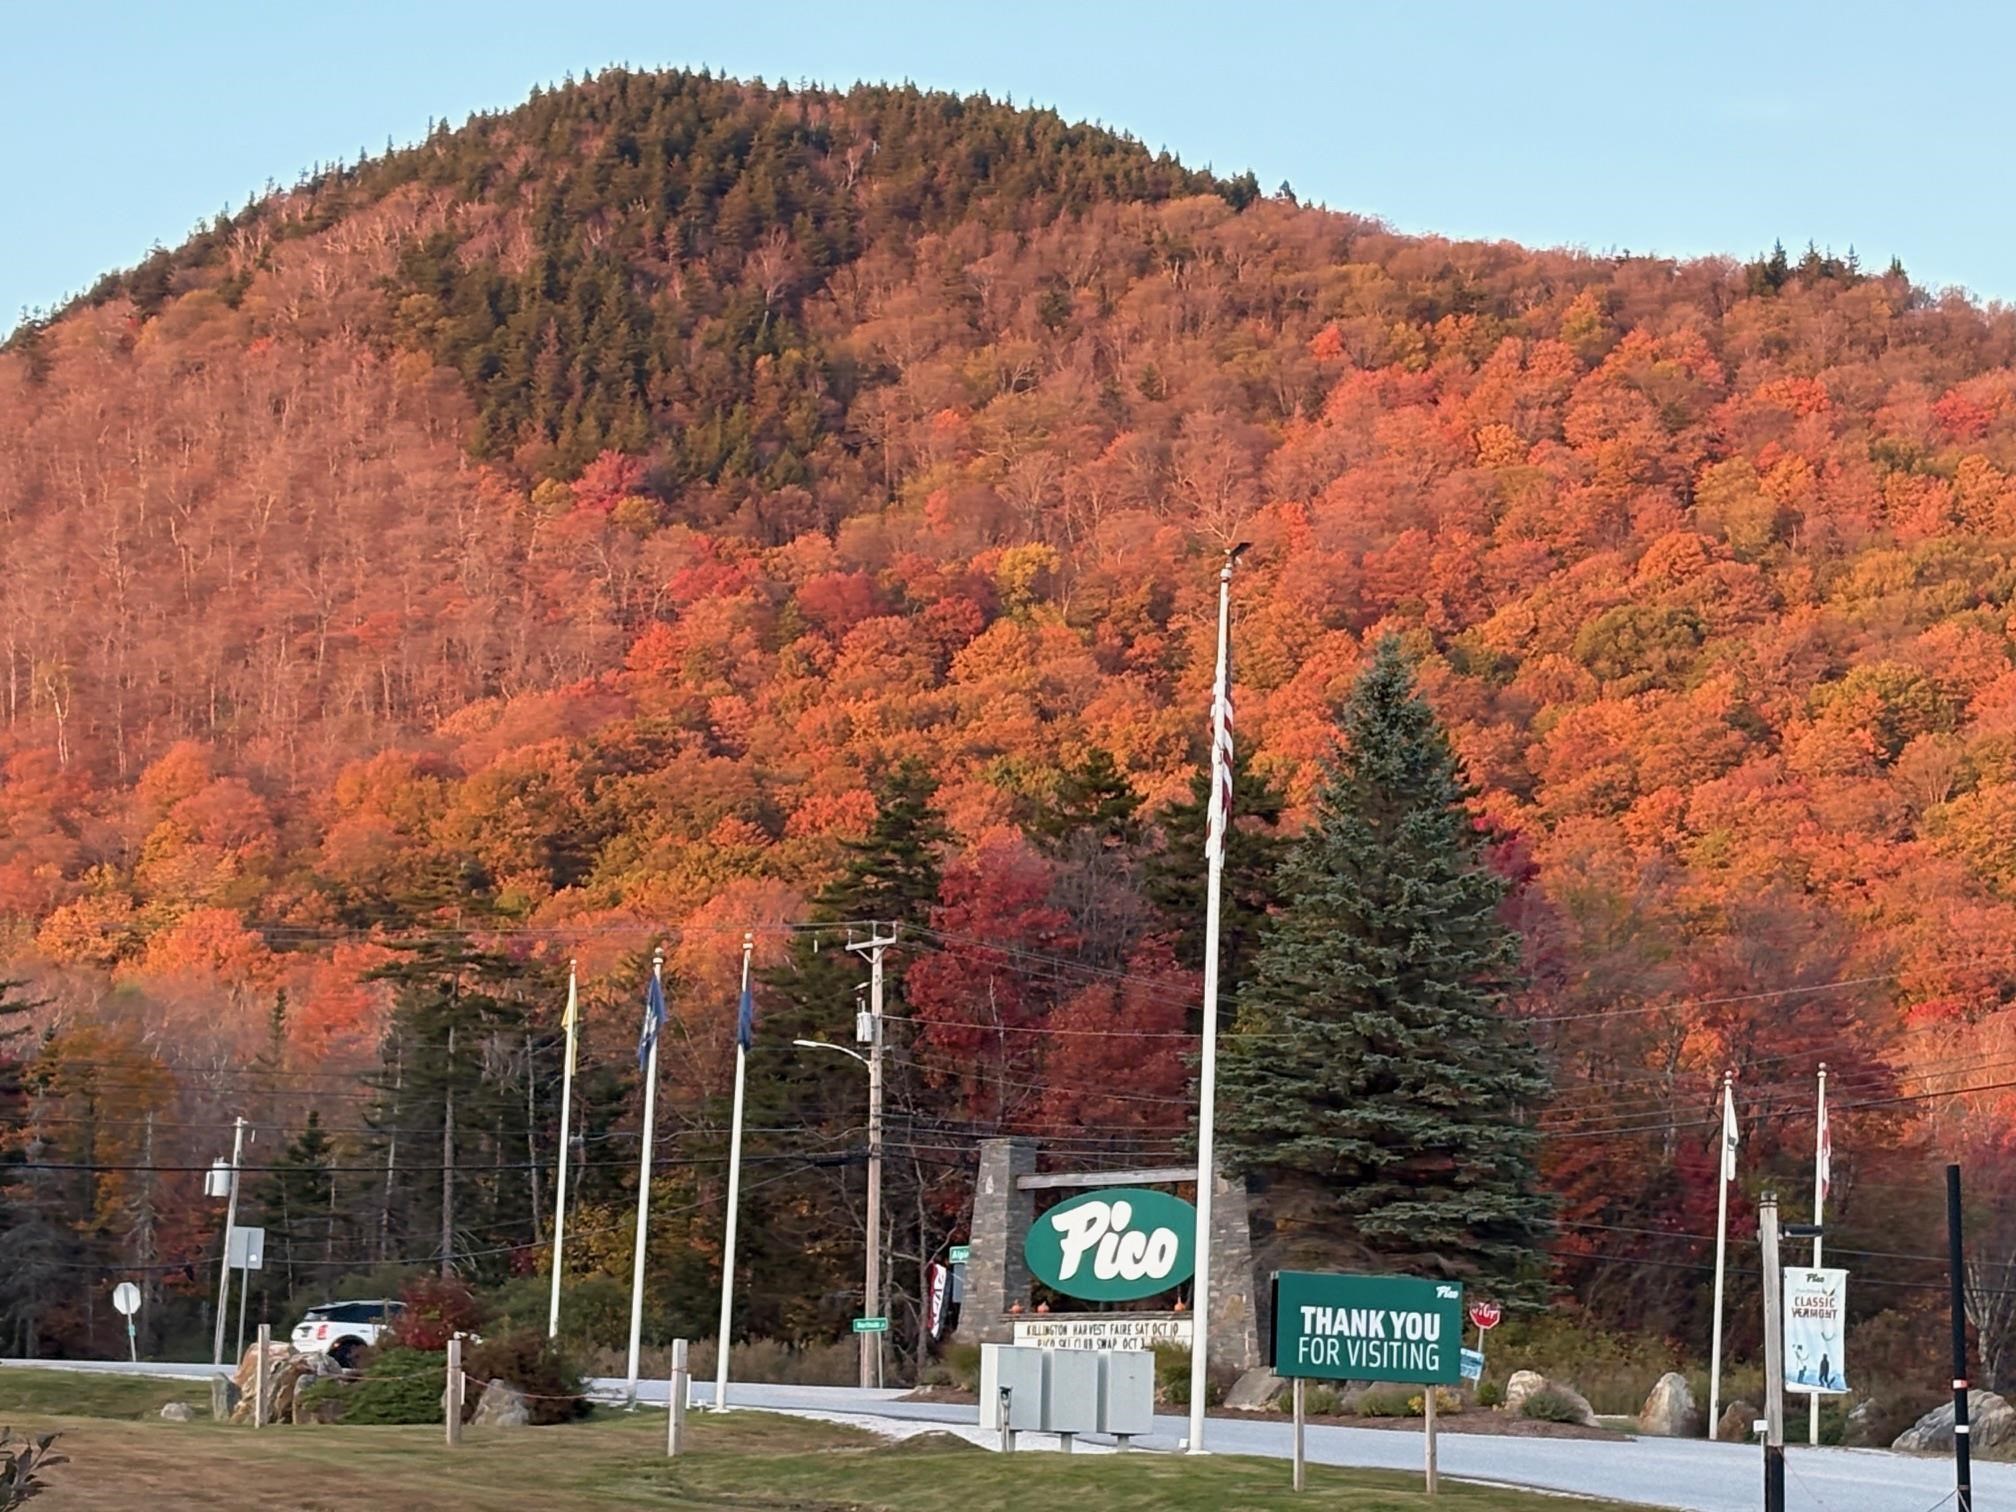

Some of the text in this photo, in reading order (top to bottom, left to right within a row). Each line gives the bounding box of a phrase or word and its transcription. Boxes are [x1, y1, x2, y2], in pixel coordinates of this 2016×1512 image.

[1051, 1200, 1178, 1281] Pico
[1794, 1296, 1835, 1308] CLASSIC
[1791, 1307, 1838, 1320] VERMONT
[1026, 1321, 1179, 1336] KILLINGTON HARVEST FAIRE SAT OCT 10
[1301, 1305, 1440, 1342] THANK YOU
[1096, 1337, 1117, 1350] SWAP
[1122, 1337, 1137, 1350] OCT
[1298, 1336, 1340, 1365] FOR
[1347, 1339, 1439, 1371] VISITING
